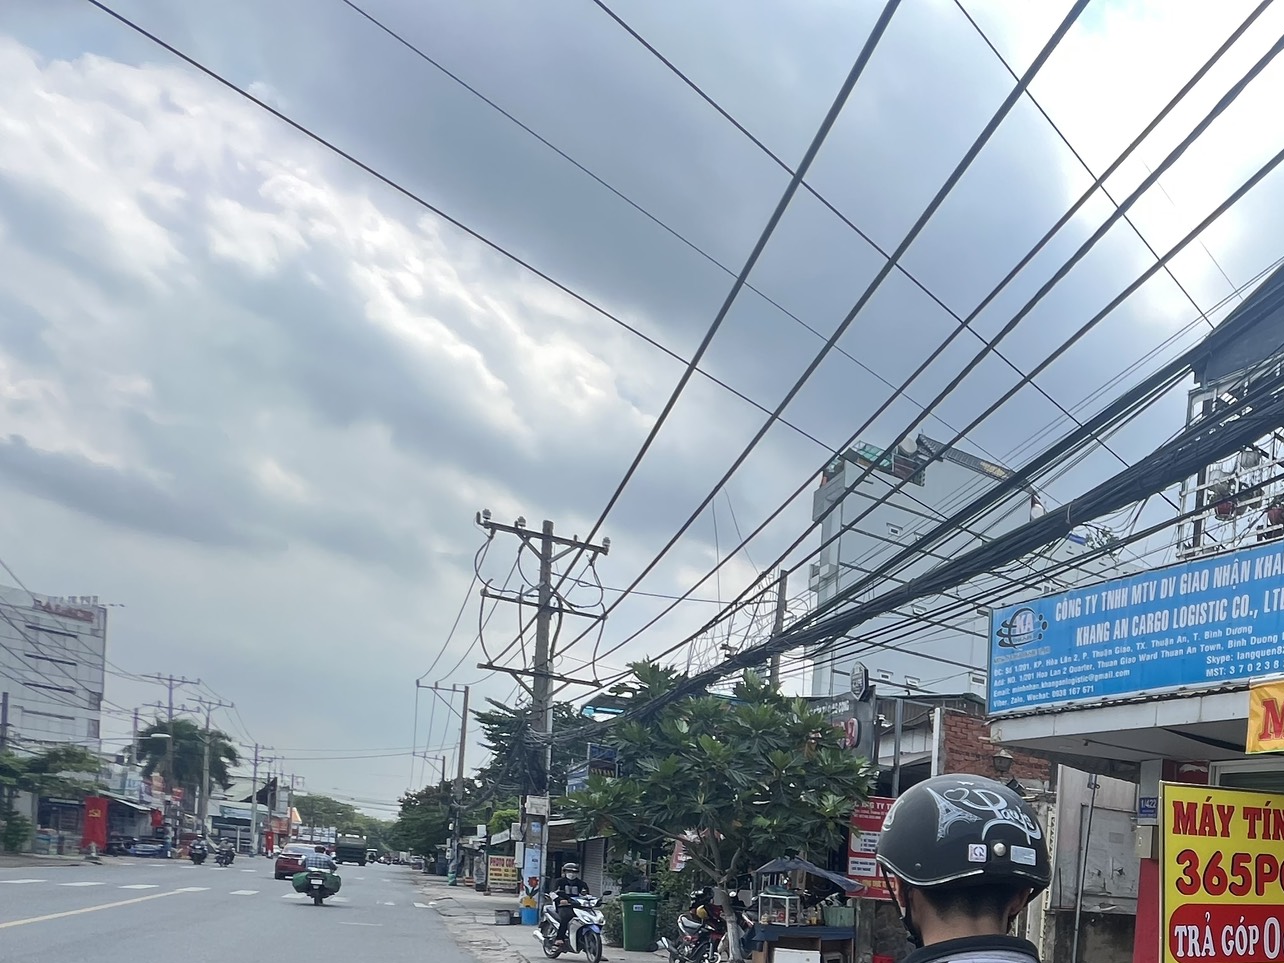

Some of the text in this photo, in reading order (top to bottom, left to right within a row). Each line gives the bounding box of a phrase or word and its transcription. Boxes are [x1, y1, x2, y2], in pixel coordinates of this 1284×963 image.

[1055, 597, 1083, 622] CÔNG
[1085, 594, 1099, 615] TY
[1101, 584, 1129, 611] TNHH
[1131, 578, 1157, 605] MTV
[1160, 576, 1177, 599] DV
[1179, 568, 1209, 596] GIAO
[1213, 558, 1252, 590] NHẬN
[1076, 621, 1111, 647] KHANG
[1113, 617, 1129, 640] AN
[1131, 609, 1170, 637] CARGO
[1172, 598, 1228, 629] LOGISTIC
[1225, 625, 1253, 637] Dương
[1120, 655, 1137, 666] Giao
[1138, 652, 1158, 663] Ward
[1186, 645, 1197, 655] An
[1250, 633, 1279, 647] Duong
[1206, 653, 1234, 666] Skype:
[1172, 796, 1235, 839] MÁY
[1174, 911, 1216, 958] TRẢ
[1221, 915, 1260, 958] GÓP
